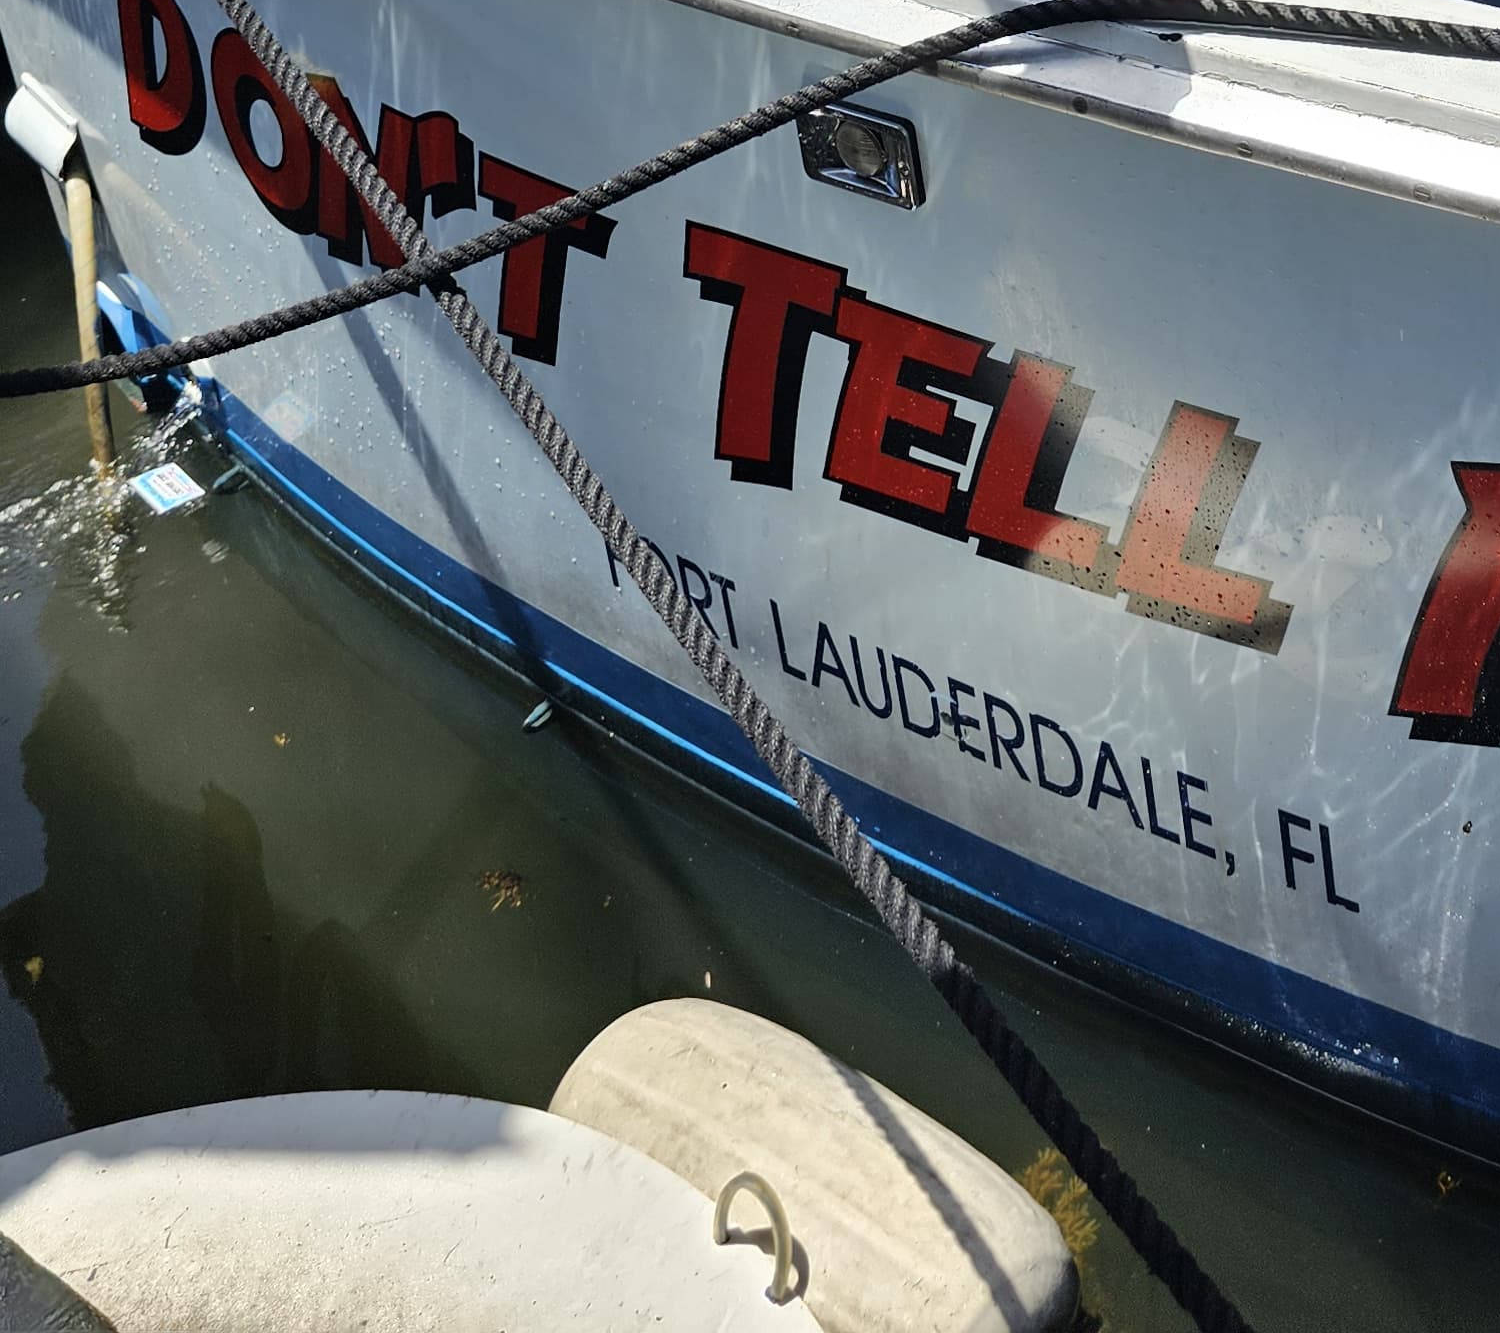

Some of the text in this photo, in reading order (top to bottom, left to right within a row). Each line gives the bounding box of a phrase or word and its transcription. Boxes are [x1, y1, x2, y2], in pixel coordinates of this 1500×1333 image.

[682, 218, 1295, 717] TELL
[769, 597, 1237, 877] LAUDERDALE,
[1277, 808, 1361, 914] FL
